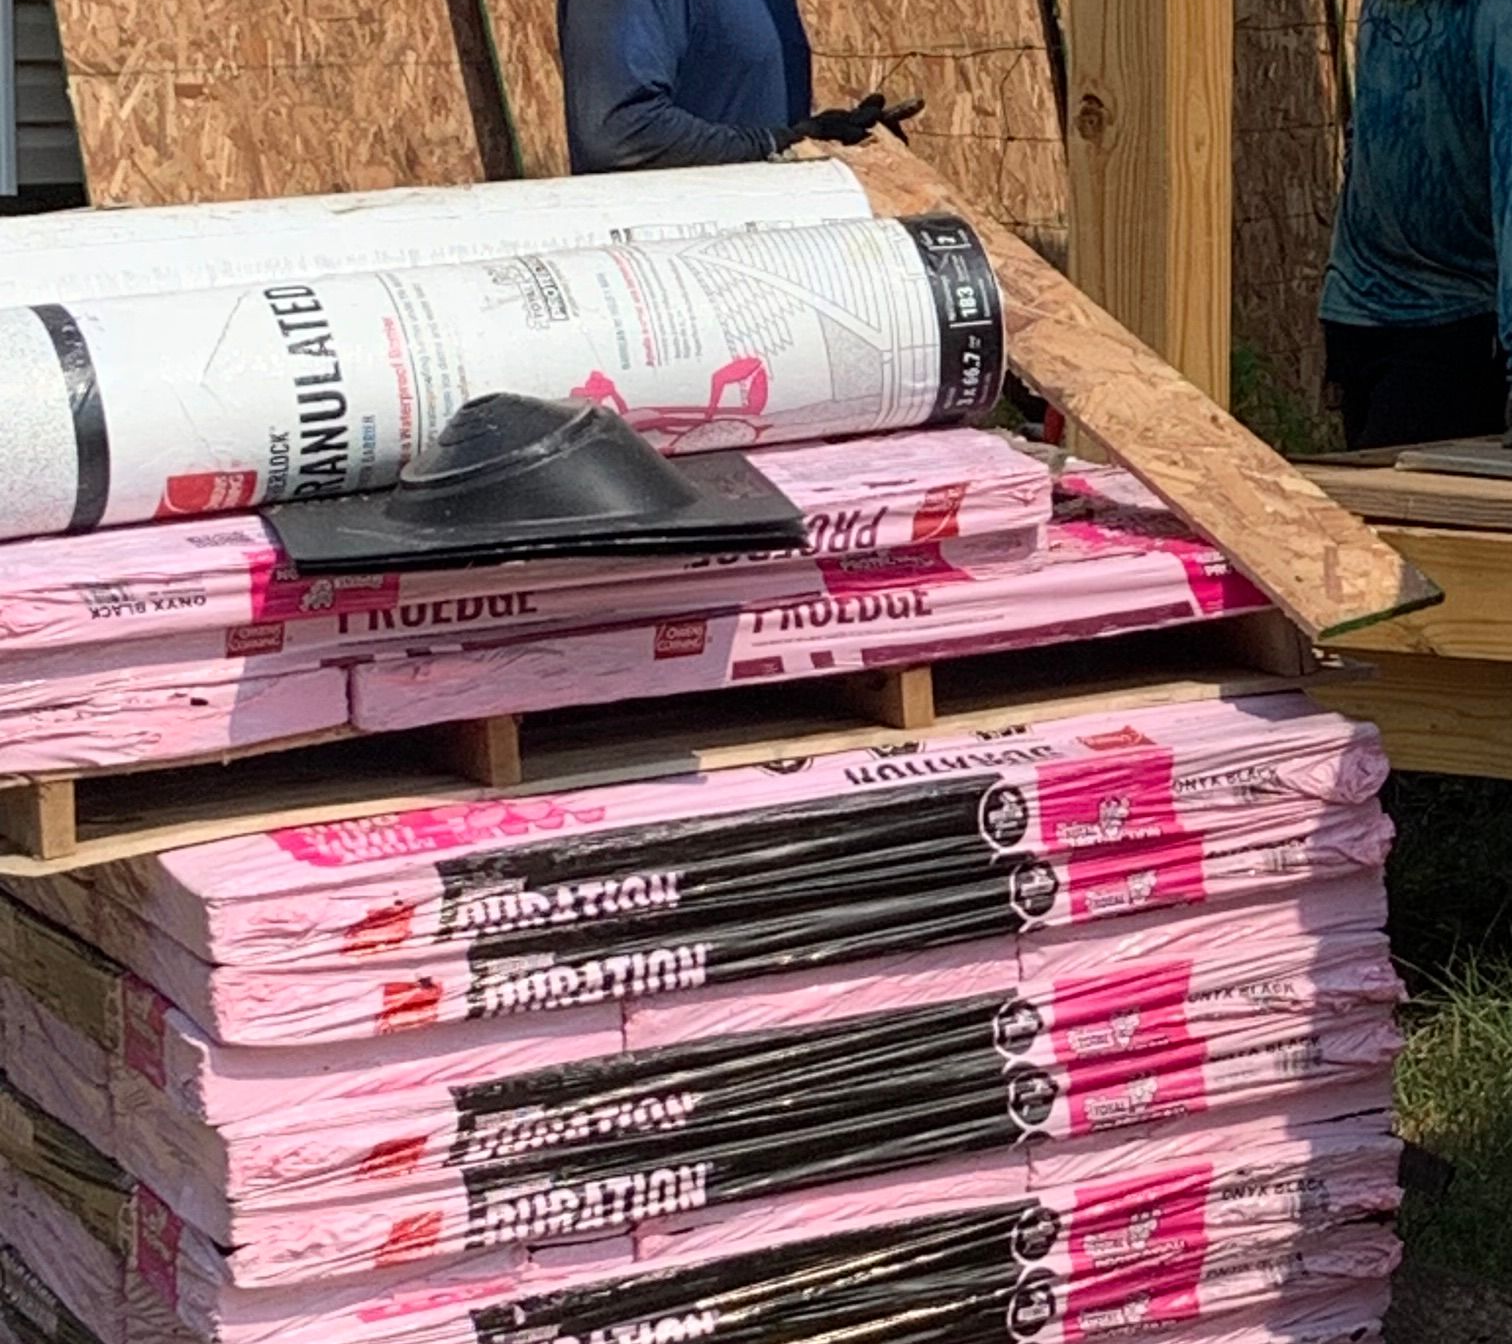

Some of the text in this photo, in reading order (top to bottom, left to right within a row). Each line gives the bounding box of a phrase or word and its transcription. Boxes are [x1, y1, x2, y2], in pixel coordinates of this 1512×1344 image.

[956, 286, 978, 318] 183
[264, 285, 348, 499] RANULATED
[89, 595, 207, 619] ONYX BLACK
[336, 591, 538, 634] ROEDGE
[751, 590, 933, 634] ROEDGE
[1221, 1184, 1269, 1201] ONYX
